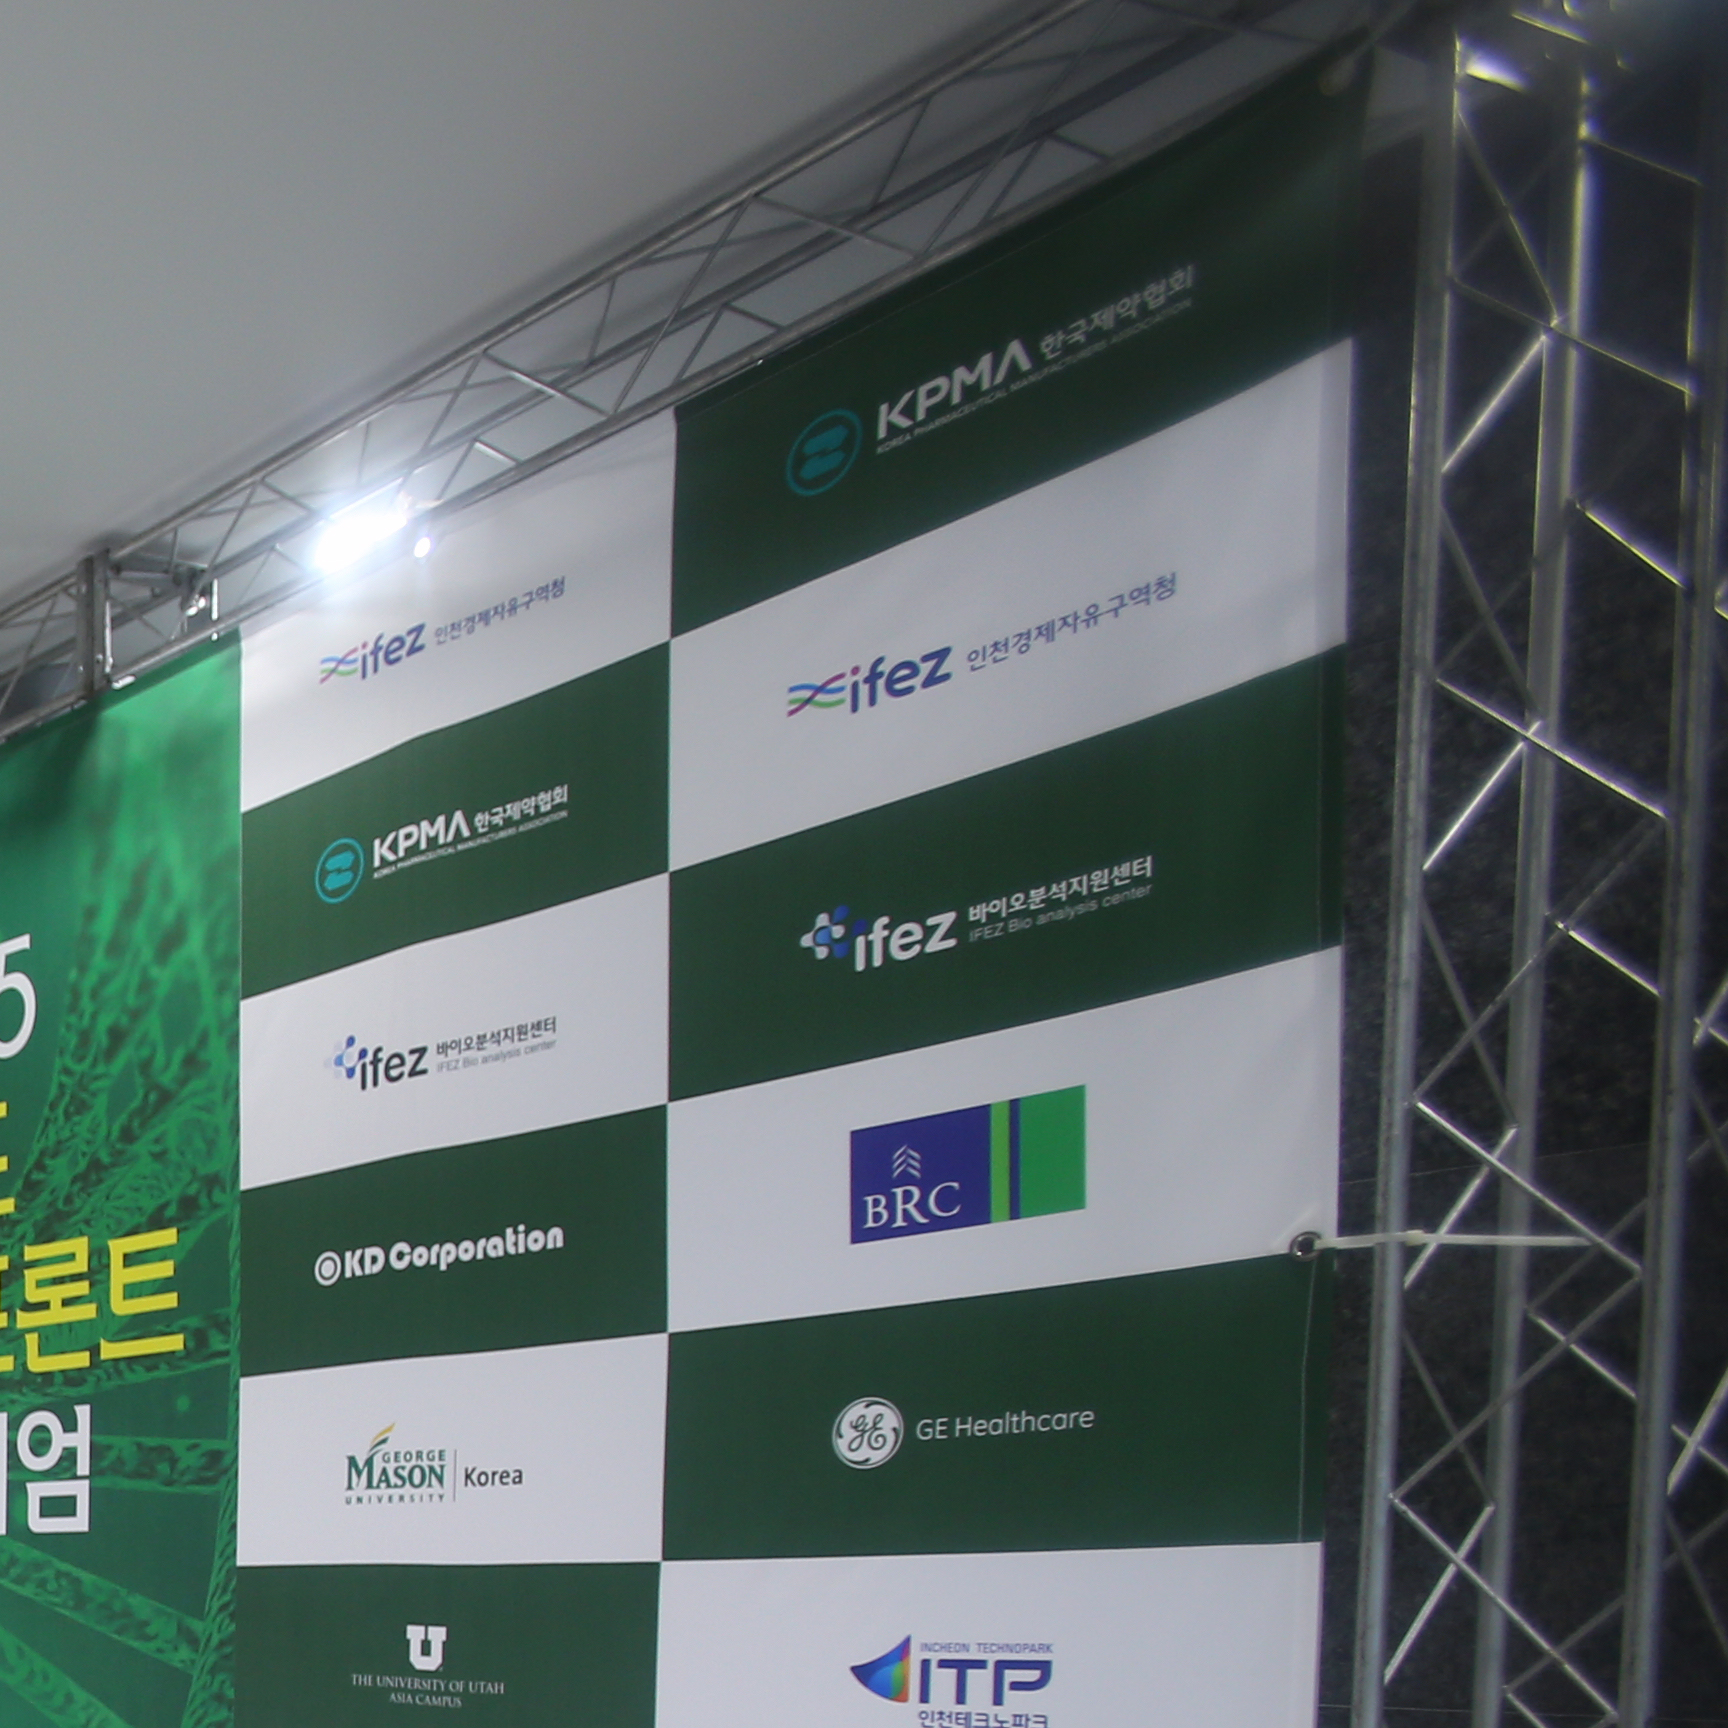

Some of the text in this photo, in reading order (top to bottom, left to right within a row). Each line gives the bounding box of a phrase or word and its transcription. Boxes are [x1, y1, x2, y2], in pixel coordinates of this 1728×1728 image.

[1040, 265, 1194, 360] 한국제약협회
[876, 339, 1033, 441] KPMA
[876, 434, 912, 455] KOREA
[435, 576, 566, 646] 인천경제자유구역청
[967, 571, 1177, 672] 인천경제자유구역청
[361, 622, 426, 680] ifez
[849, 646, 952, 714] ifez
[474, 784, 568, 833] 한국제약협회
[373, 809, 471, 868] KPMA
[968, 855, 1153, 923] 바이오분석지원센터
[969, 883, 1153, 943] IFEZ Bio analysis center
[854, 911, 957, 972] ifez
[436, 1016, 556, 1057] 바이오분석지원센터
[360, 1045, 429, 1090] ifez
[863, 1181, 961, 1229] BRC
[344, 1224, 564, 1278] KD Corporation
[916, 1410, 1094, 1440] GE Healthcare
[346, 1453, 446, 1491] MASON
[382, 1449, 446, 1463] GEORGE
[464, 1467, 523, 1487] Korea
[345, 1493, 445, 1505] UNIVERSITY
[921, 1642, 1053, 1654] INCHEON TECHNOPARK
[352, 1674, 505, 1695] THE UNIVERSITY OF UTAH
[389, 1692, 462, 1708] ASIA CAMPUS
[919, 1659, 1052, 1706] ITP
